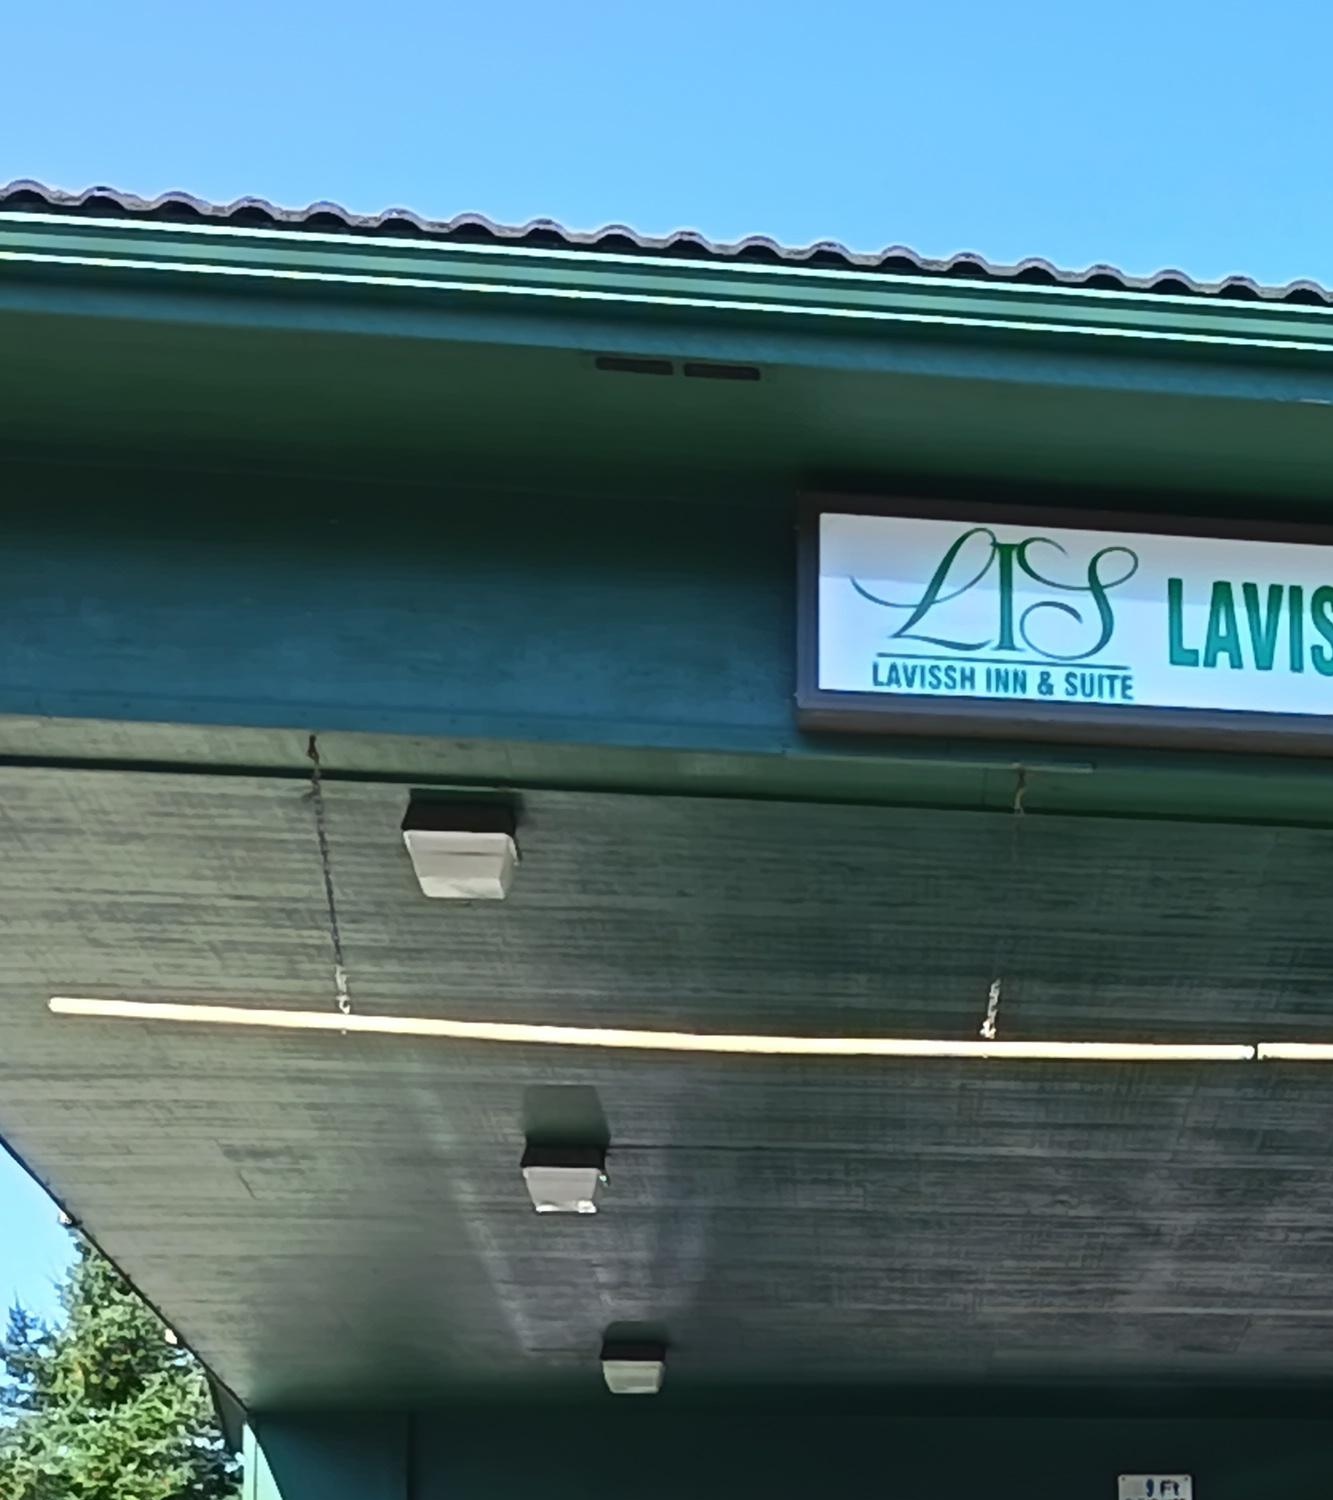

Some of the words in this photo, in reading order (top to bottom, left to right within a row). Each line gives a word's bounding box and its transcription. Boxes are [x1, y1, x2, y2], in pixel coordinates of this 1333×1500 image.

[872, 661, 976, 692] LAVISSH
[986, 666, 1028, 695] INN
[1037, 670, 1055, 696] &
[1065, 671, 1135, 700] SUITE
